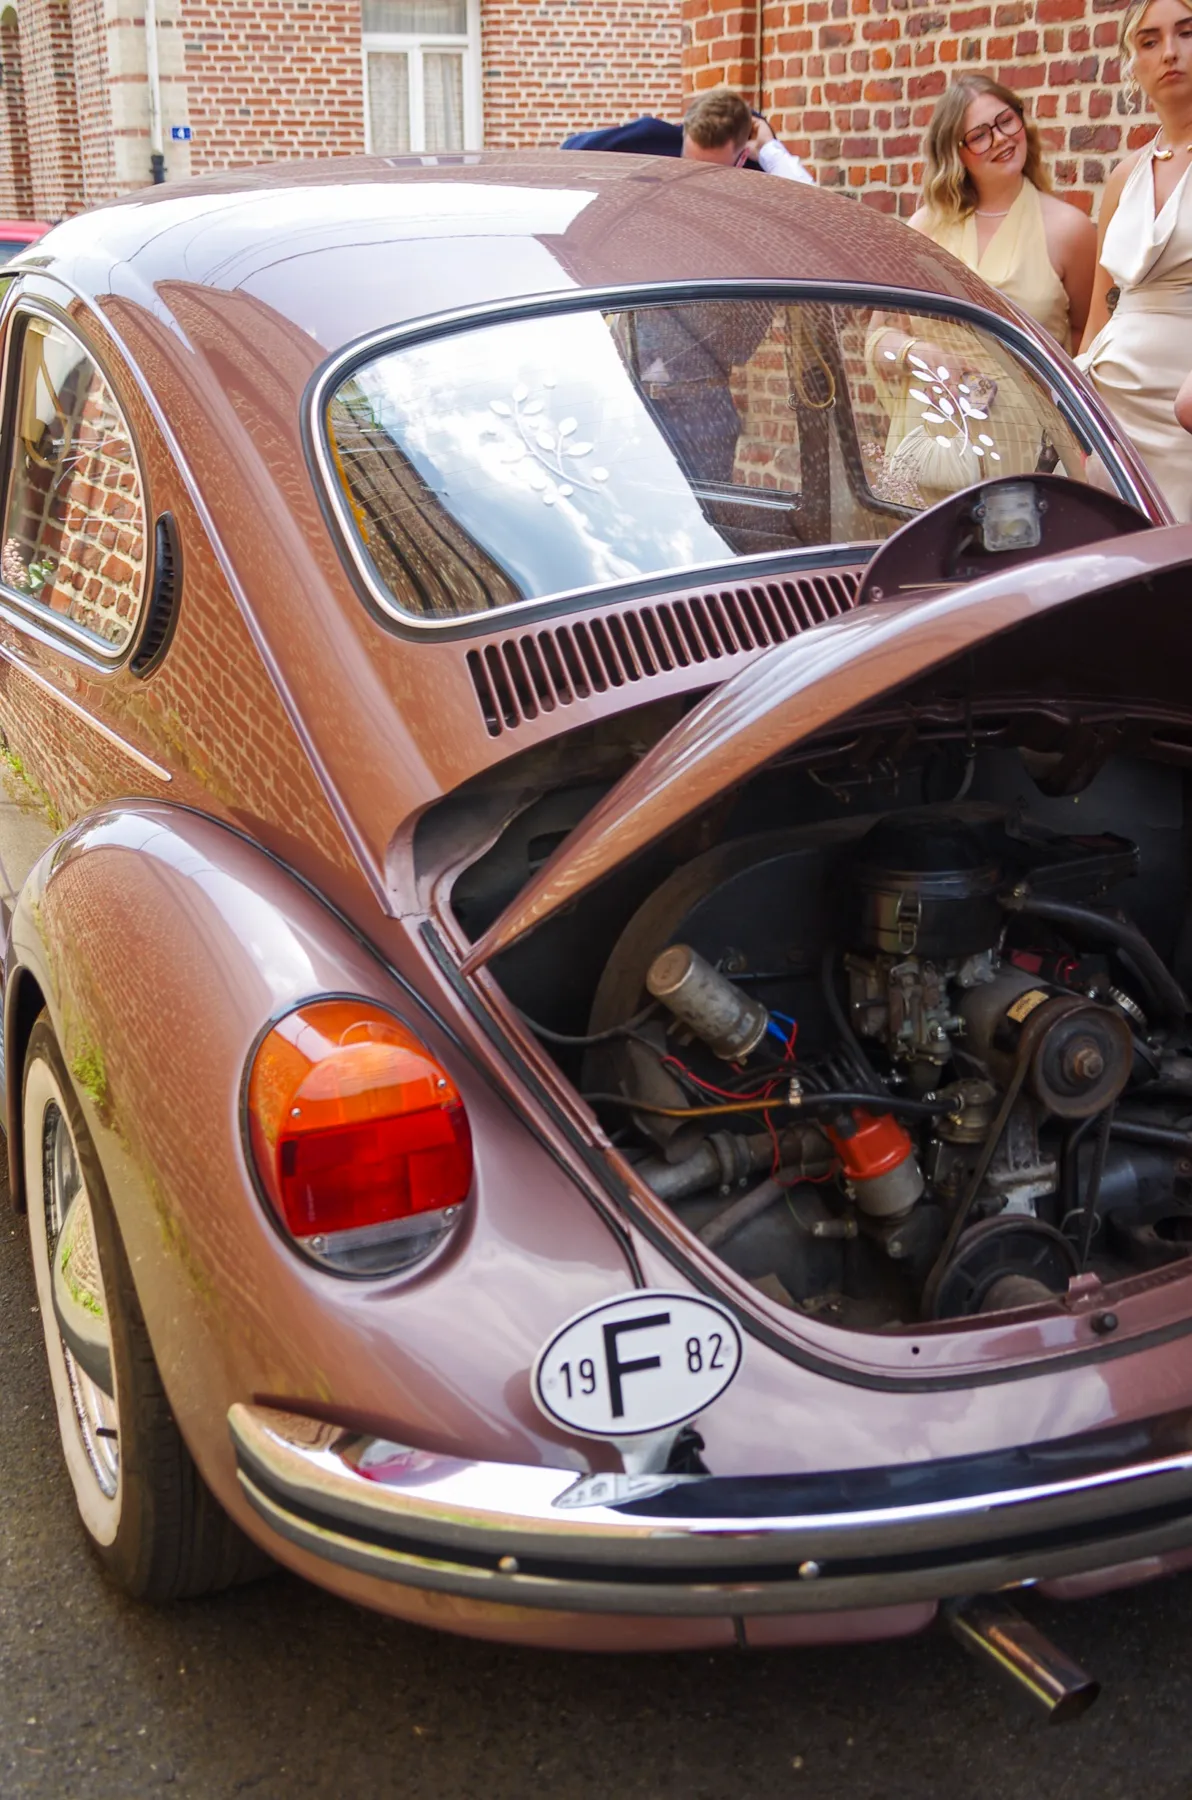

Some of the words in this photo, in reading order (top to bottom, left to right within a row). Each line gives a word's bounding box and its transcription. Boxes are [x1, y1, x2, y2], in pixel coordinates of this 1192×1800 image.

[560, 1359, 596, 1399] 19
[602, 1312, 671, 1419] F
[686, 1333, 724, 1373] 82
